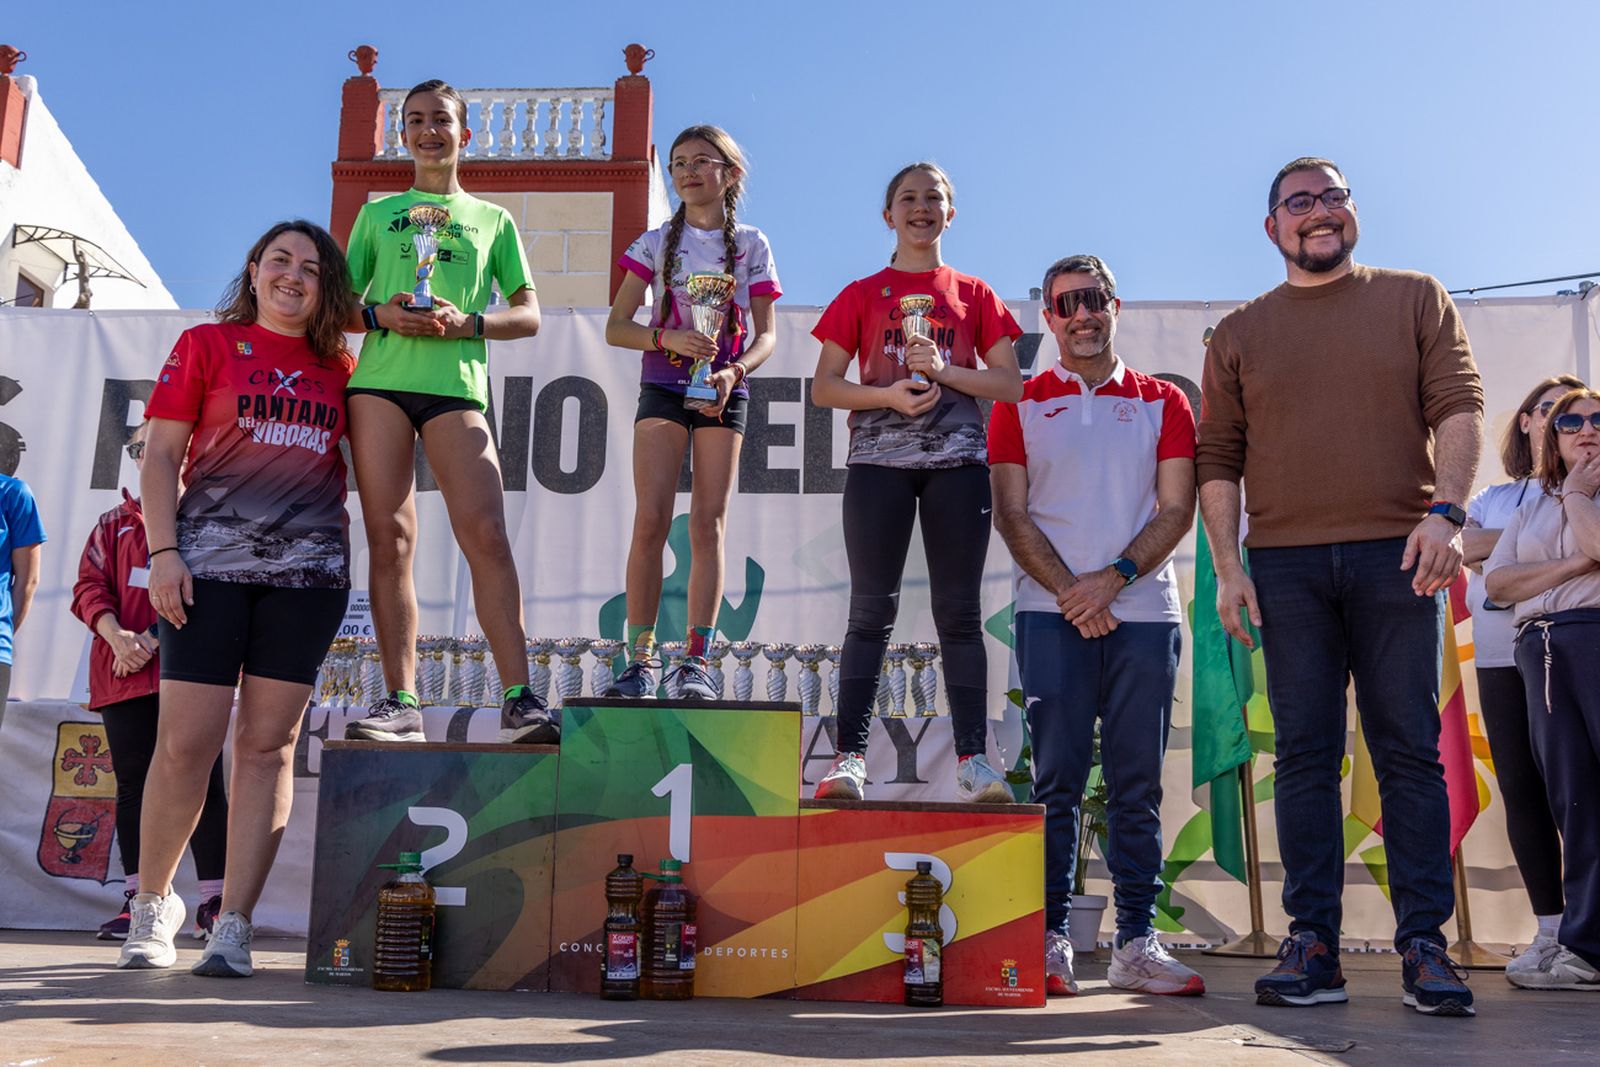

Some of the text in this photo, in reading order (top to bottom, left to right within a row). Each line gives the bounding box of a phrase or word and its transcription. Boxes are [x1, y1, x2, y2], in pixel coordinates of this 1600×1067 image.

[238, 394, 339, 431] PANTANO
[238, 415, 331, 455] DEL VÍBORAS
[363, 624, 371, 635] €
[651, 763, 693, 864] 1
[408, 806, 468, 907] 2
[883, 852, 958, 955] 3
[559, 942, 604, 954] CONC
[704, 945, 789, 959] DEPORTES
